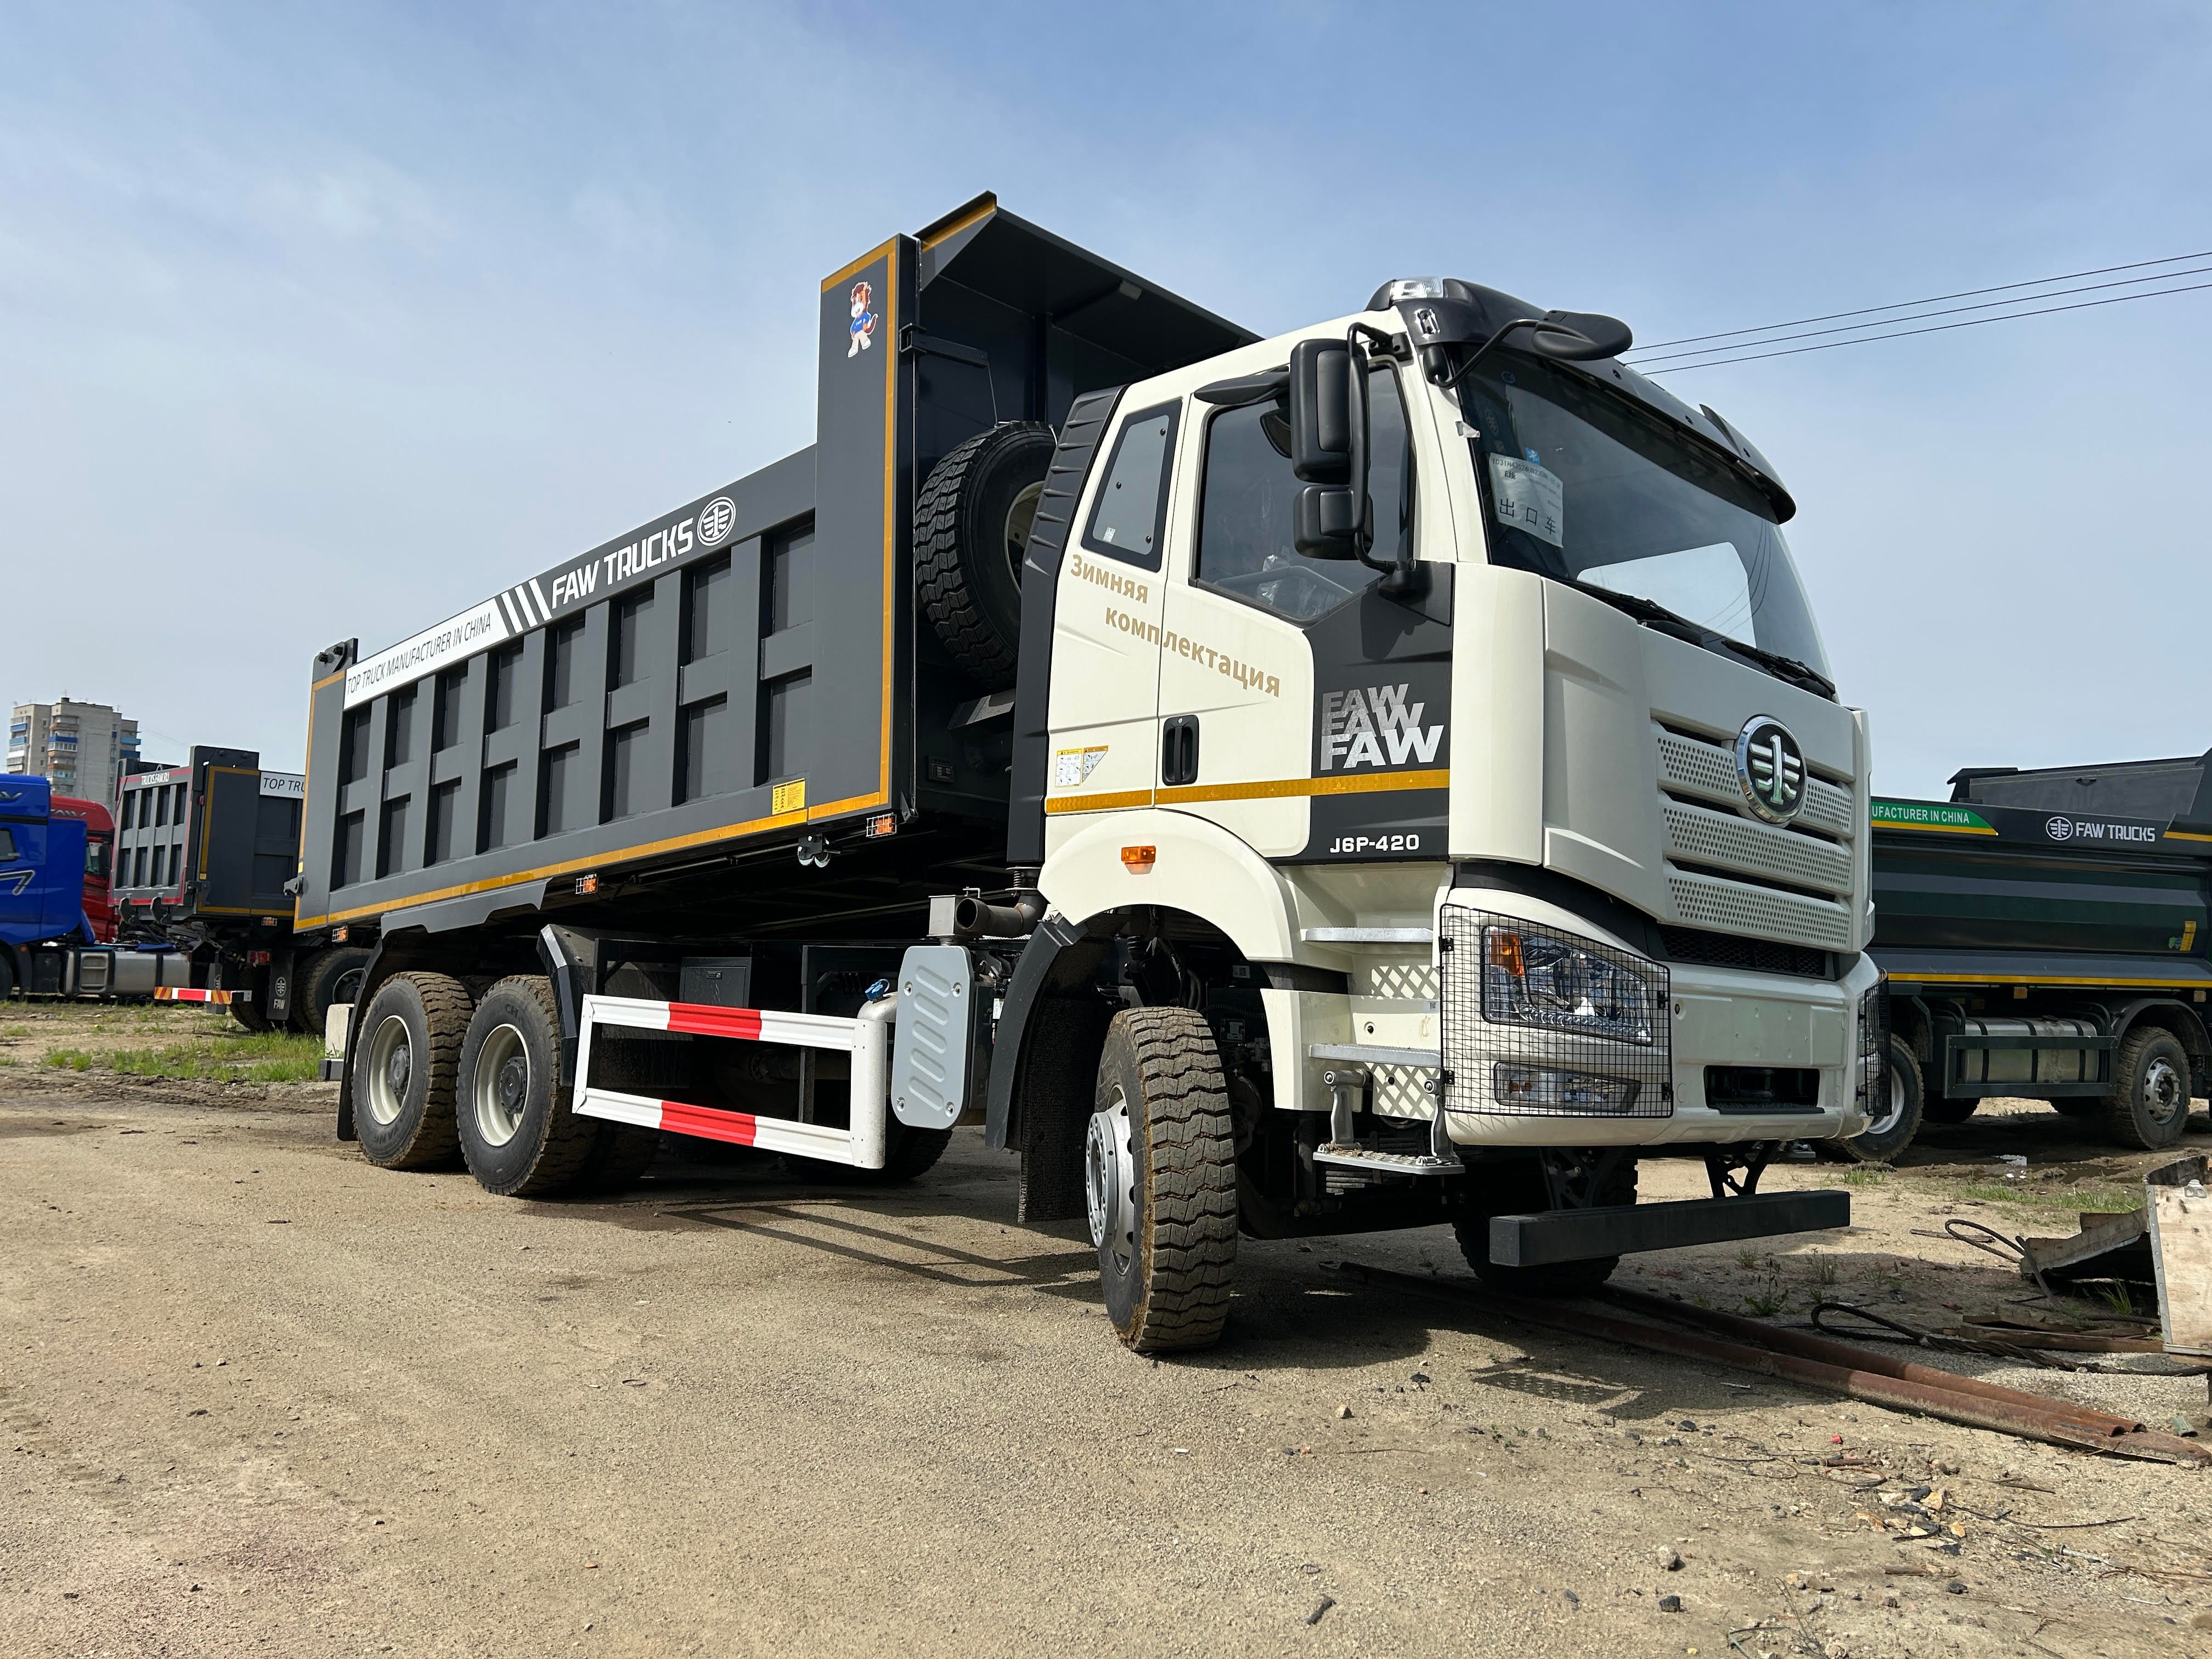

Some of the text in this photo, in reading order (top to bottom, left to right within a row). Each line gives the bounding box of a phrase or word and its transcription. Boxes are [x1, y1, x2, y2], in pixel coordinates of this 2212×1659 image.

[1499, 498, 1556, 535] 出口车
[552, 517, 694, 609] FAW TRUCKS
[1070, 554, 1149, 604] Зимняя
[347, 612, 491, 695] TOP TRUCK MANUFACTURER IN CHINA
[1105, 607, 1280, 698] комплектация
[1320, 725, 1444, 771] FAW
[263, 777, 285, 790] TOP
[1930, 810, 1939, 821] IN
[1941, 811, 1970, 824] CHINA
[2076, 822, 2156, 842] FAW TRUCKS
[1330, 834, 1420, 853] J6P-420
[273, 998, 286, 1010] FAW
